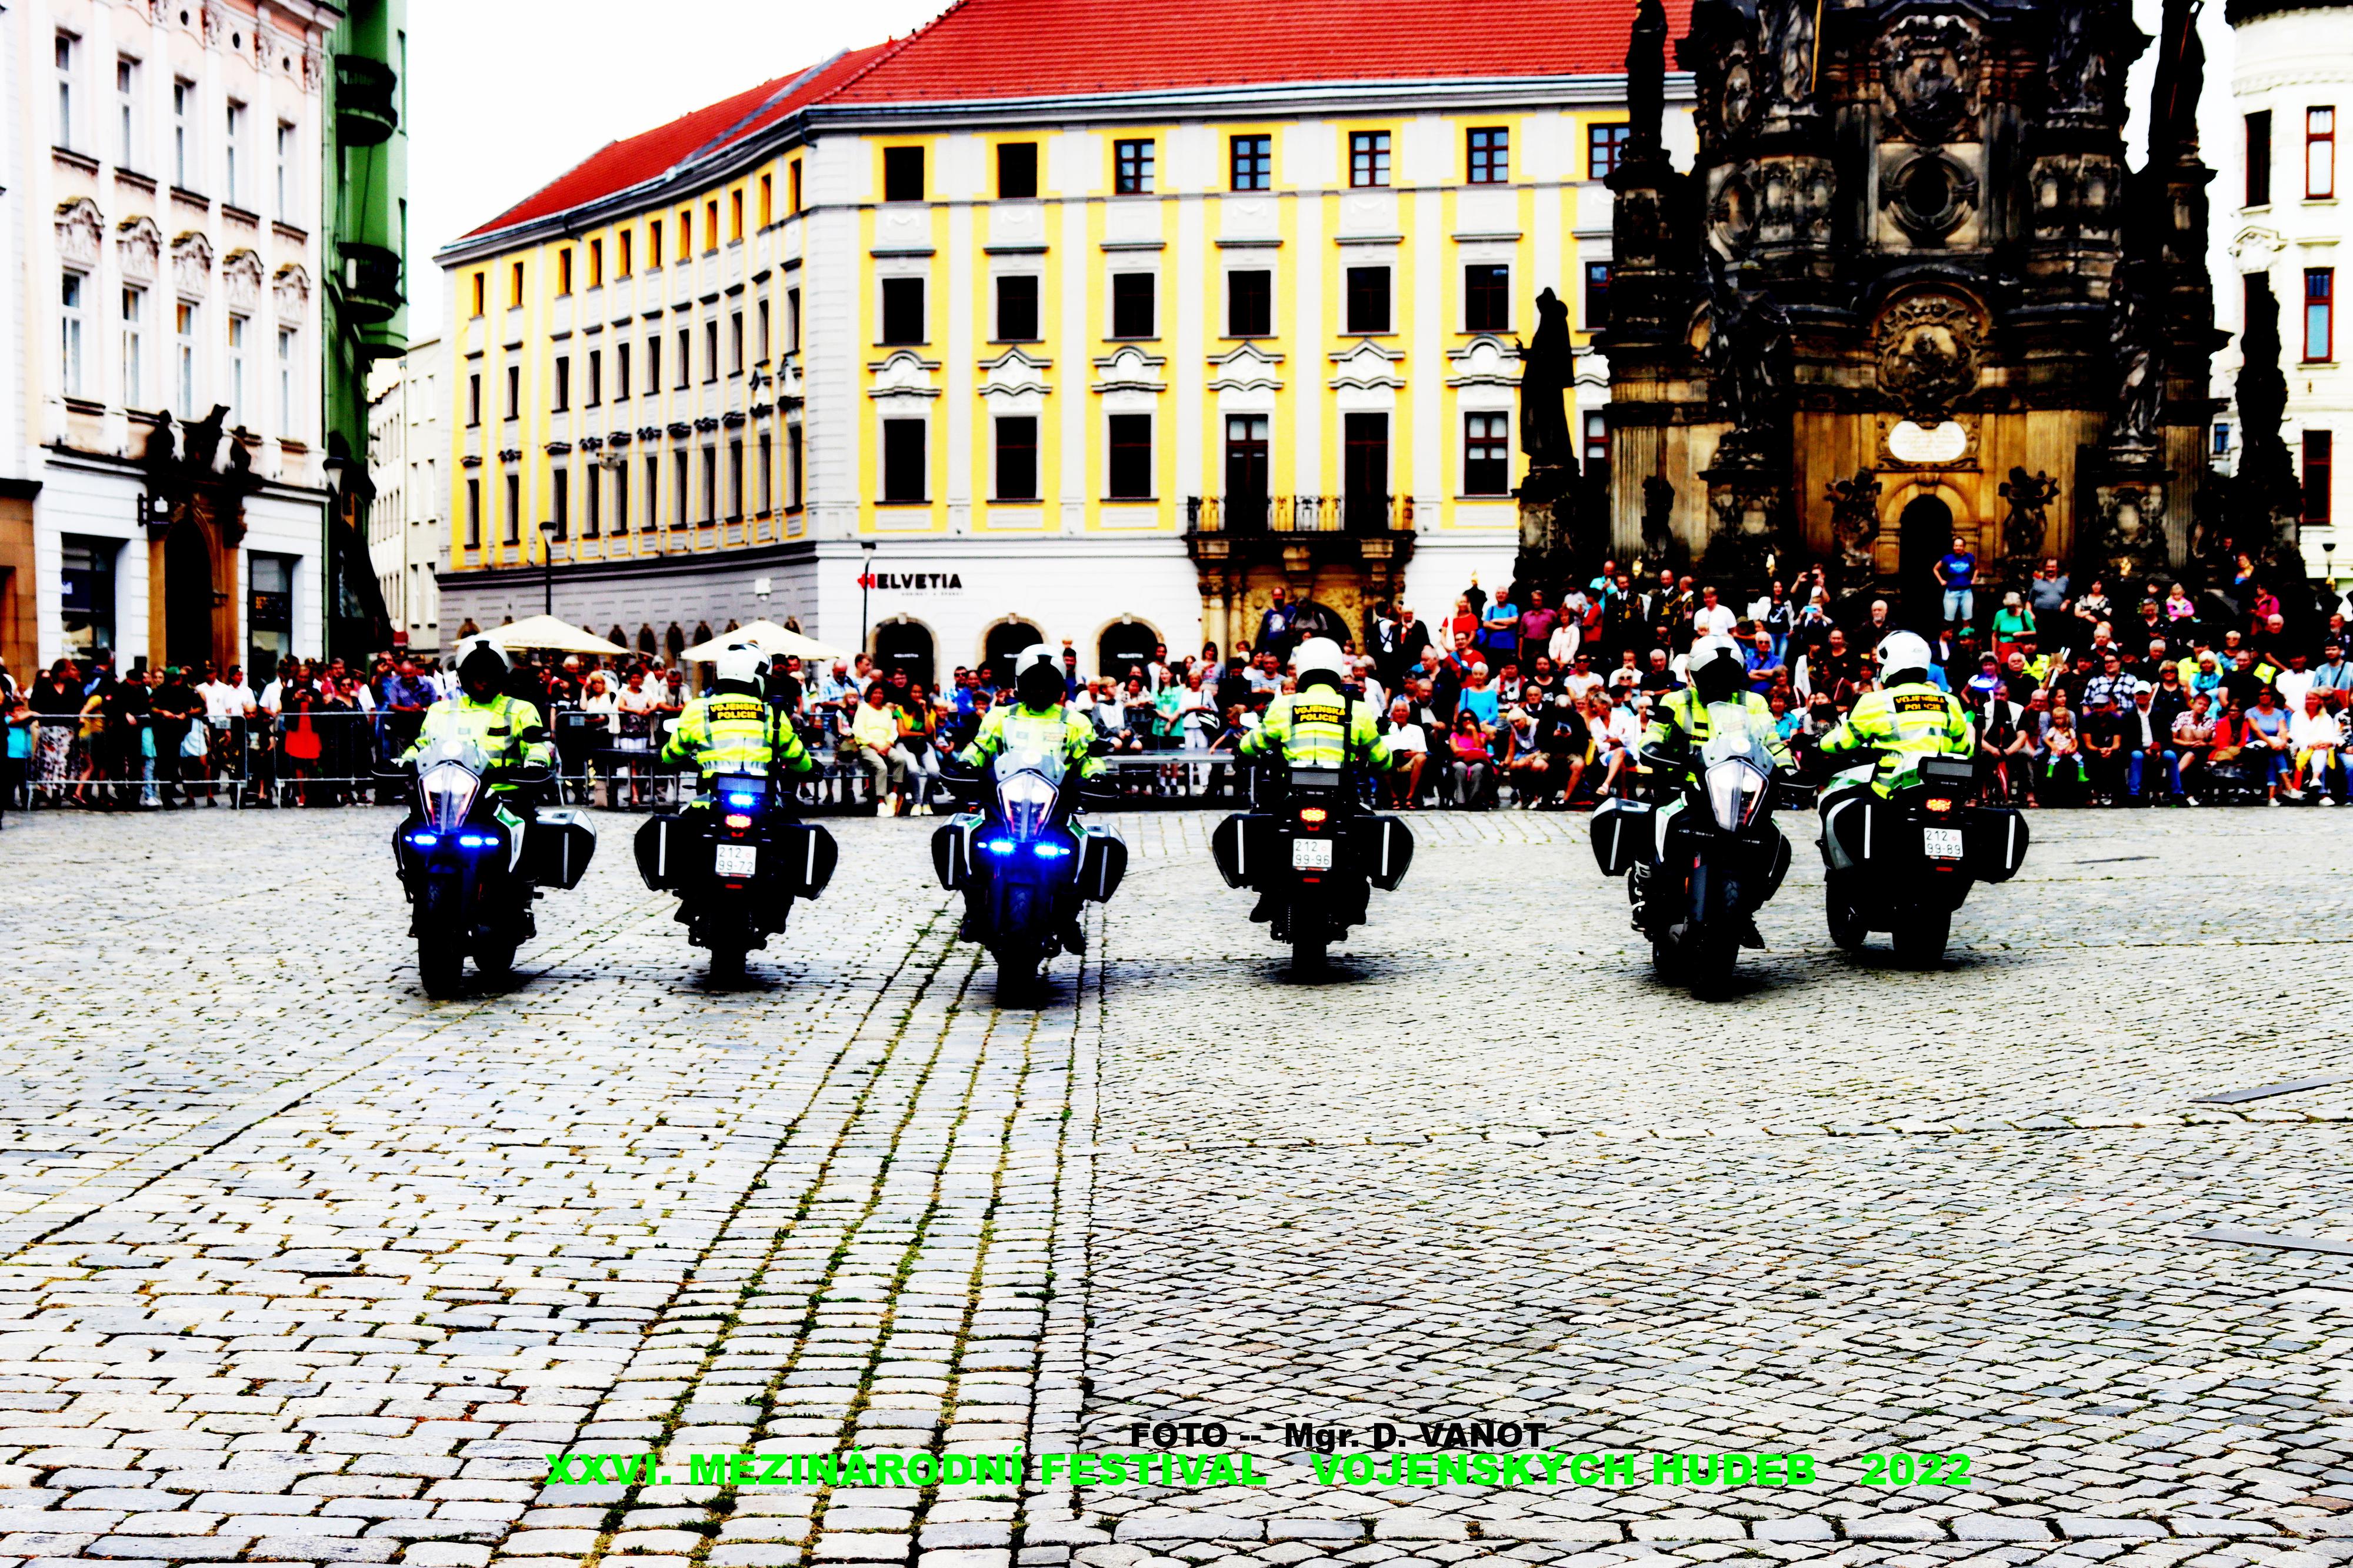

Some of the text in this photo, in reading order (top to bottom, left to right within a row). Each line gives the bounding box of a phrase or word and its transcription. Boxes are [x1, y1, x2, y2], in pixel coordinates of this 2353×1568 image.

[857, 573, 962, 589] HELVETIA
[1299, 713, 1339, 722] POLICIE
[1926, 830, 1948, 841] 212
[1295, 841, 1317, 852] 212
[1927, 843, 1961, 855] 99-89
[719, 847, 741, 858] 212
[1295, 854, 1330, 865] 99-96
[718, 860, 754, 872] 99-72
